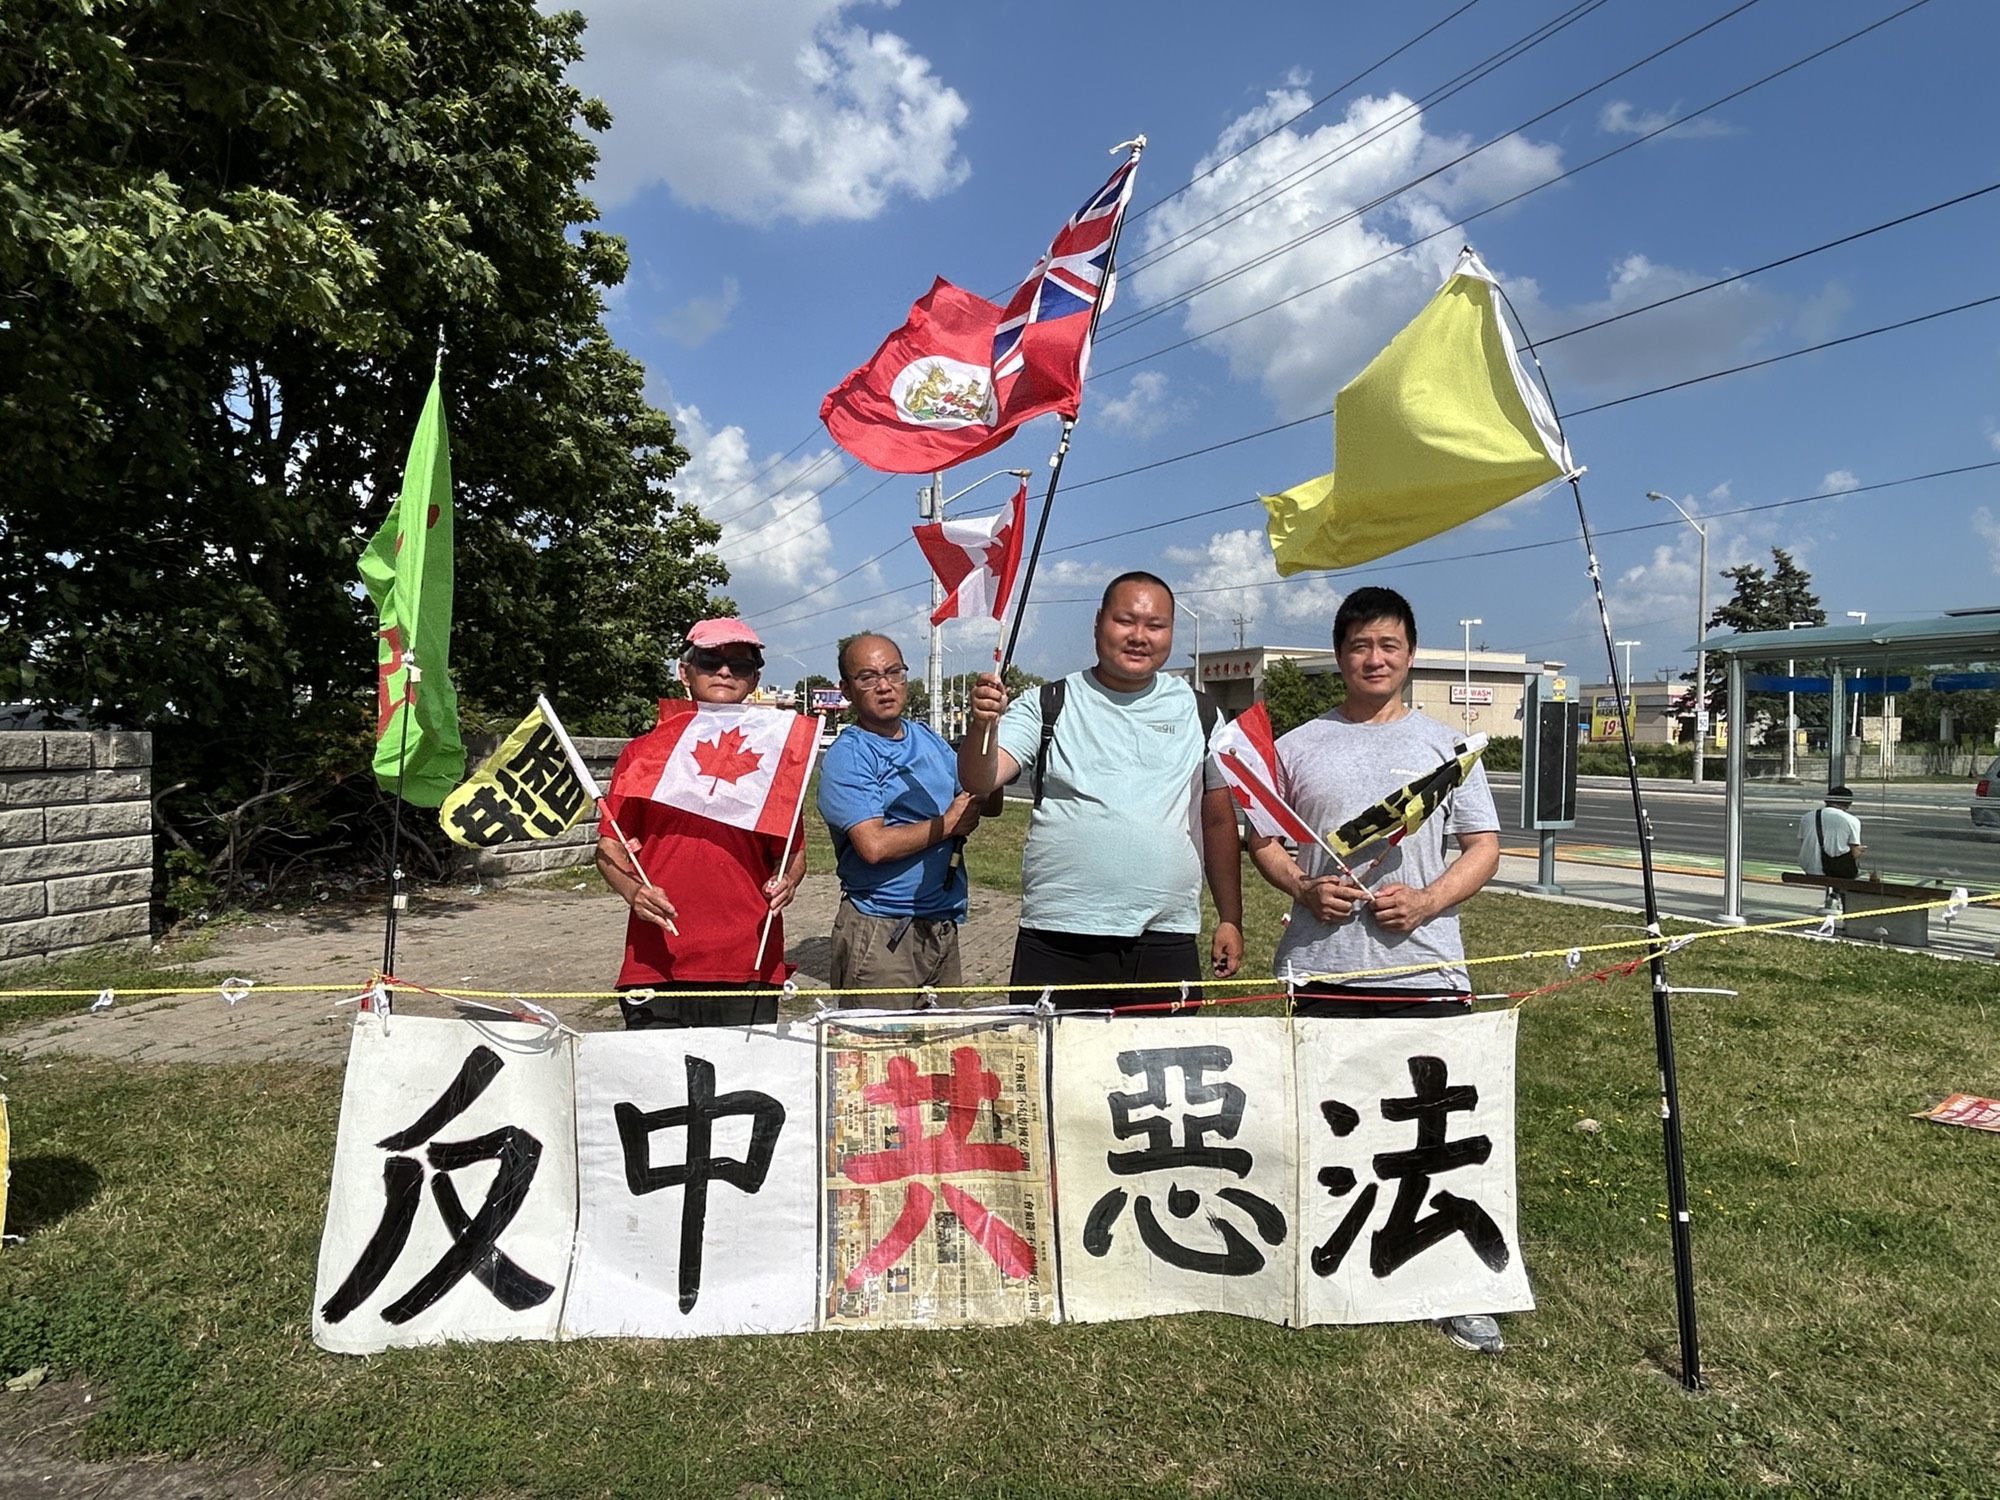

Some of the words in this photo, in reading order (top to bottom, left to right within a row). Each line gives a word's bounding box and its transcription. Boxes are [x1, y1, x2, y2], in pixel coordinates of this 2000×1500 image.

[1470, 689, 1492, 697] WASH
[1699, 719, 1707, 728] 50
[320, 1045, 1510, 1325] 反中共惡法
